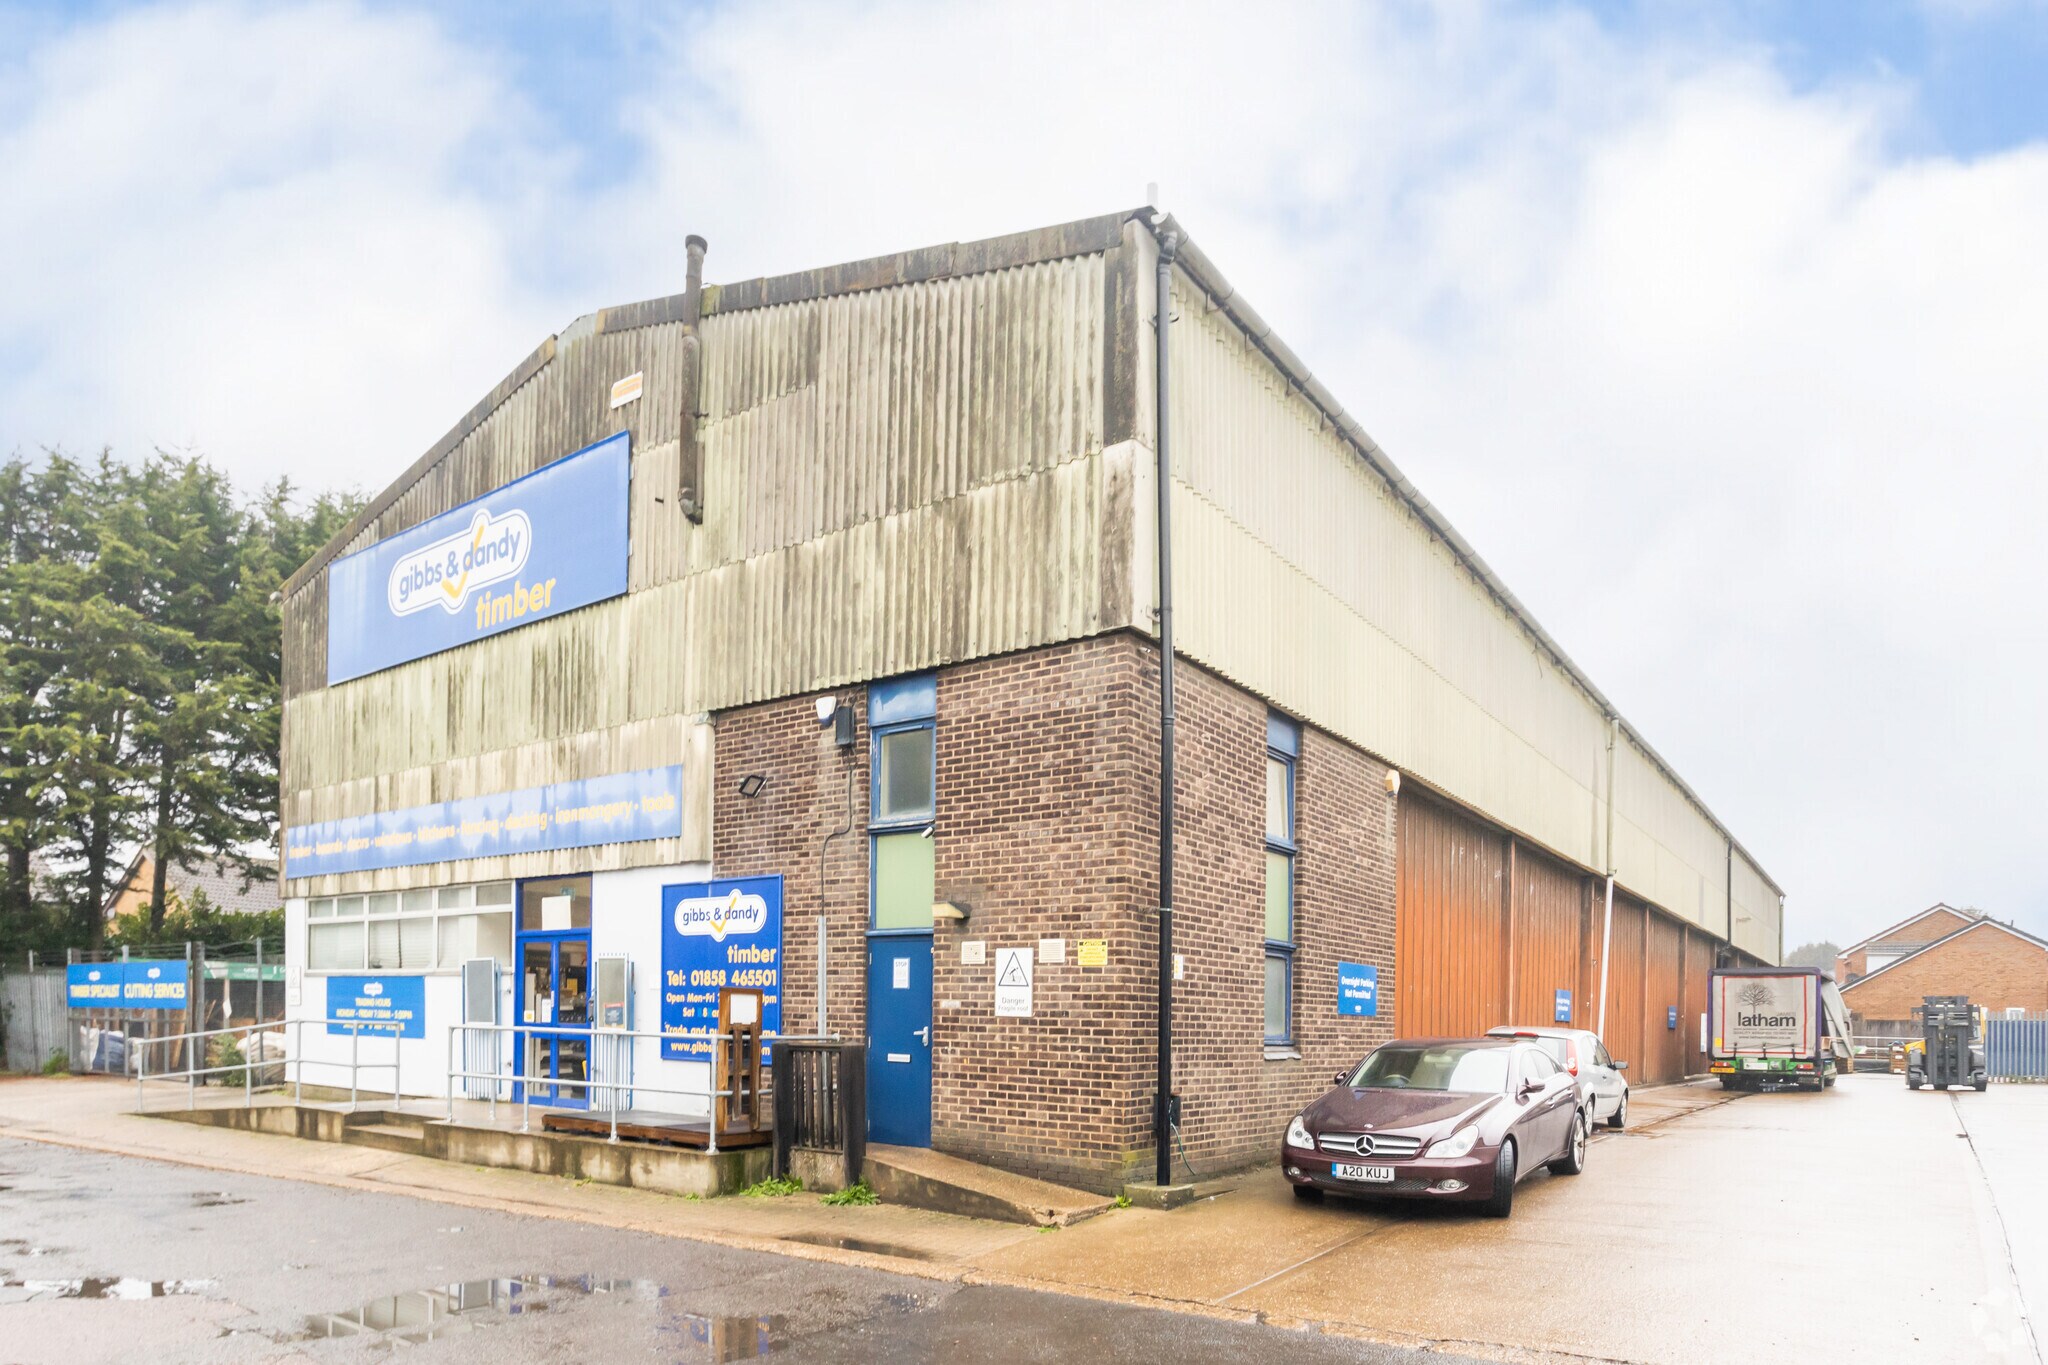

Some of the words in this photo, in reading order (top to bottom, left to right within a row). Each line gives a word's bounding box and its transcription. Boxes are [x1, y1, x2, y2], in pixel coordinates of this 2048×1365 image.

[400, 562, 442, 604] gibbs
[446, 552, 459, 578] &
[463, 526, 520, 570] dandy
[476, 578, 557, 630] timber
[505, 811, 548, 831] decking
[555, 799, 633, 824] ironmongery
[642, 792, 674, 812] tools
[683, 907, 711, 926] gibbs
[714, 907, 722, 921] &
[725, 905, 759, 923] dandy
[727, 944, 777, 964] timber
[667, 970, 687, 987] Tel:
[691, 970, 726, 987] 01858
[731, 969, 777, 987] 465501
[1341, 976, 1360, 987] Overnight
[1360, 978, 1374, 989] Parking
[124, 983, 153, 999] CUTTING
[154, 982, 185, 999] SERVICES
[666, 993, 685, 1005] Open
[687, 992, 715, 1004] Mon-Fri
[1001, 997, 1025, 1005] Danger
[682, 1007, 695, 1017] Sat
[703, 1007, 708, 1017] 8
[1738, 1011, 1796, 1027] latham
[665, 1023, 688, 1034] Trade
[690, 1025, 706, 1035] and
[1342, 1165, 1363, 1177] A20
[1366, 1167, 1389, 1179] KUJ
